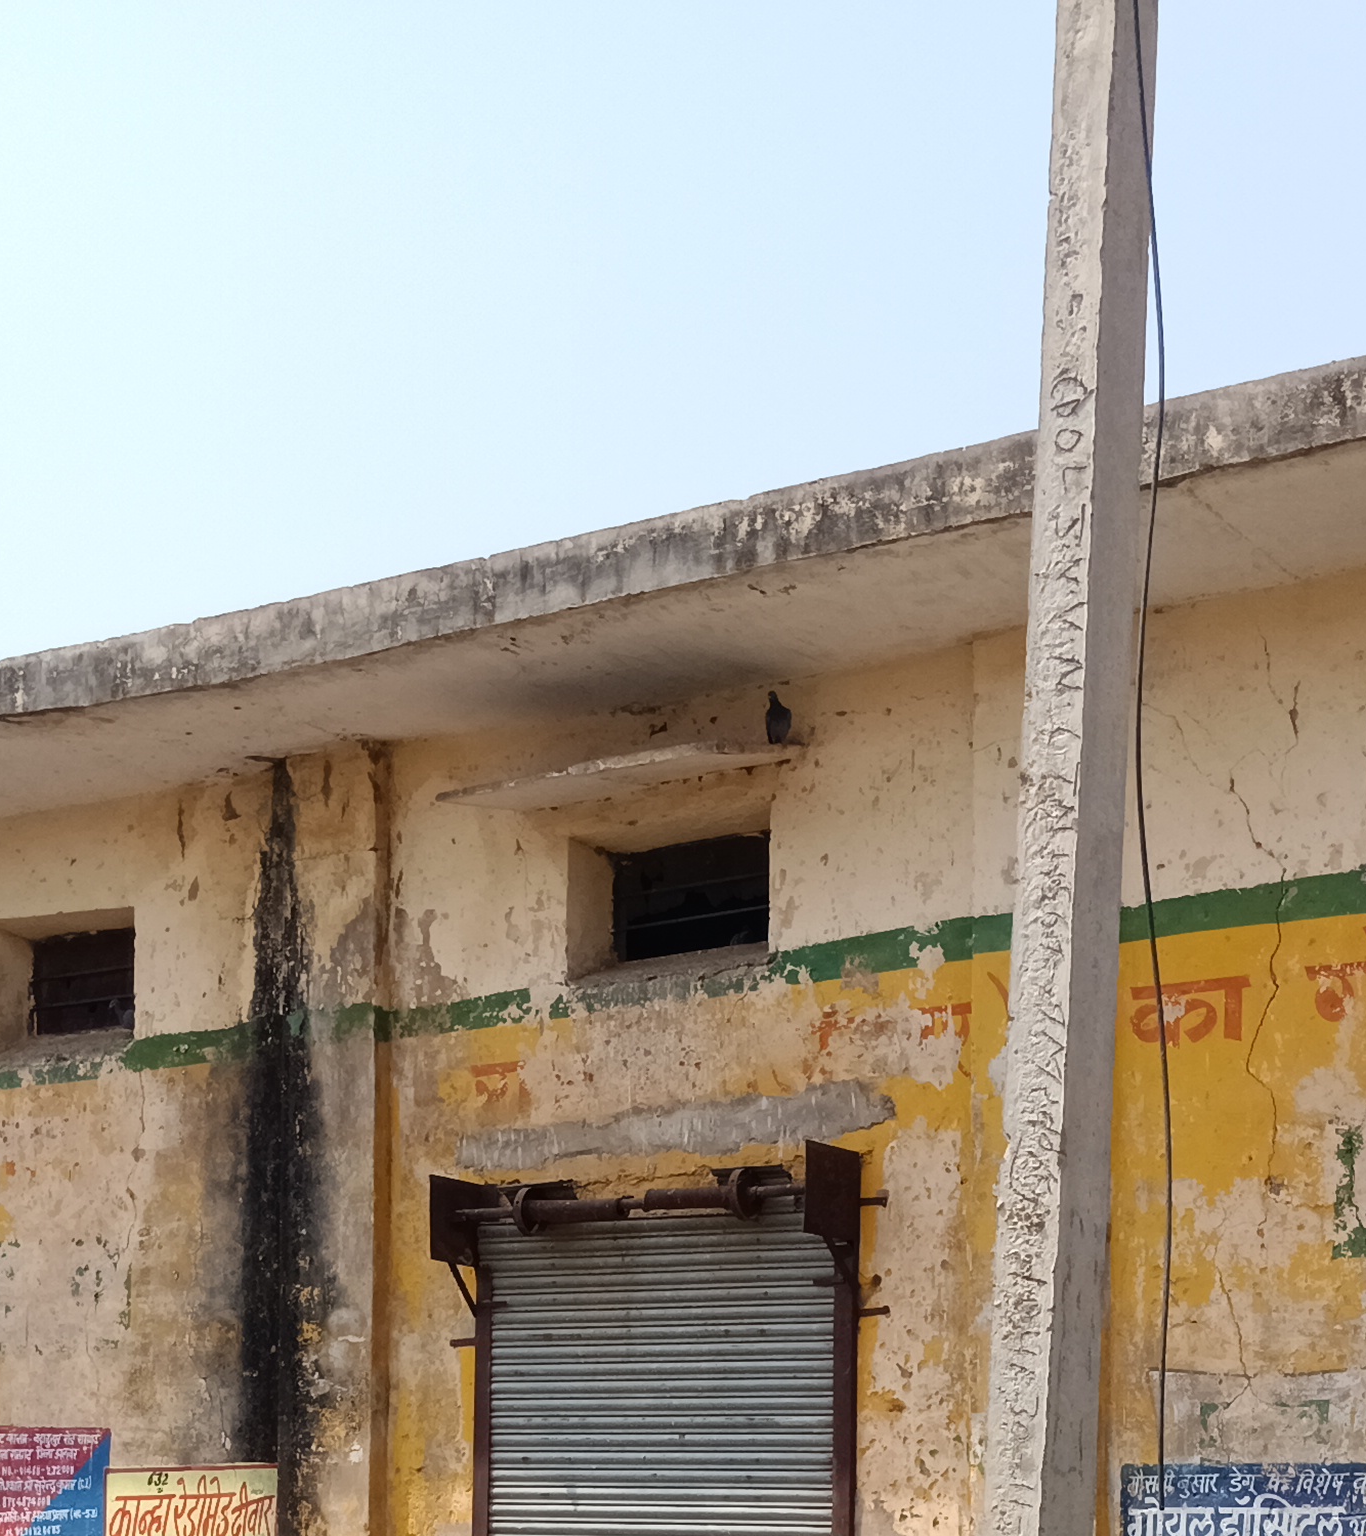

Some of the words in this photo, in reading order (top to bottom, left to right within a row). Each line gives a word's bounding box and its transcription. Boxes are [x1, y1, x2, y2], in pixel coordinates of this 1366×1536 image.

[1130, 974, 1252, 1050] का
[147, 1472, 170, 1486] 632
[1295, 1467, 1351, 1500] विशेष
